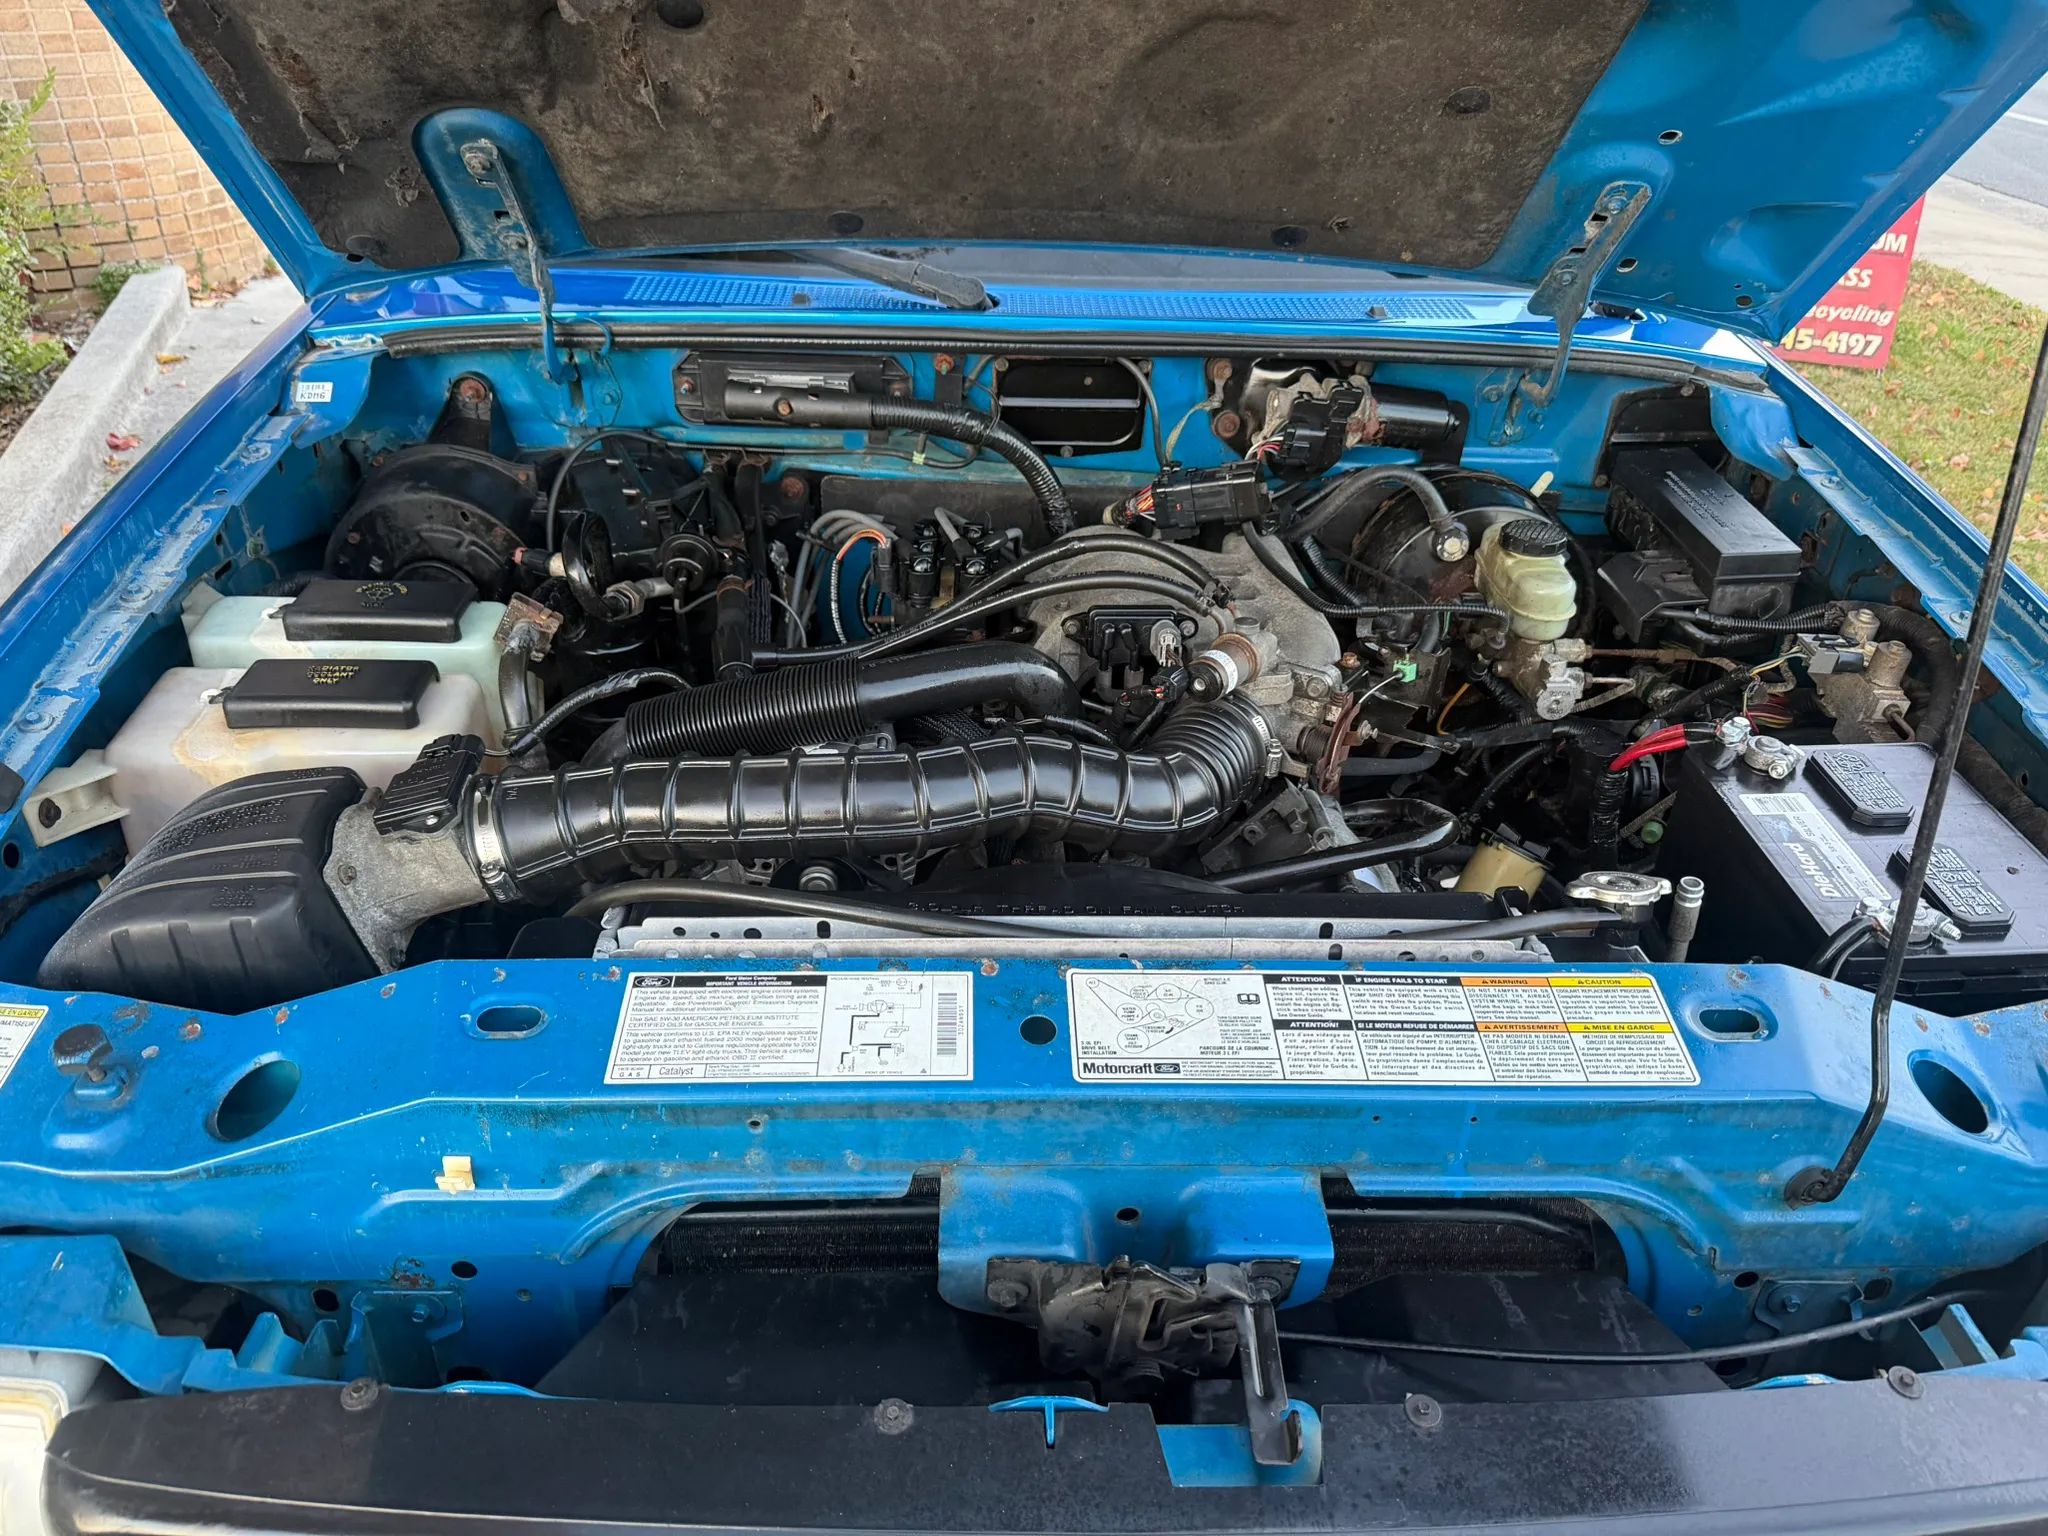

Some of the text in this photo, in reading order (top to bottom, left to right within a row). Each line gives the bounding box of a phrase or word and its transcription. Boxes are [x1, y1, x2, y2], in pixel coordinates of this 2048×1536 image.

[1783, 841, 1843, 898] DieHard
[659, 1067, 694, 1076] Catalyst
[1083, 1062, 1153, 1074] Motorcraft
